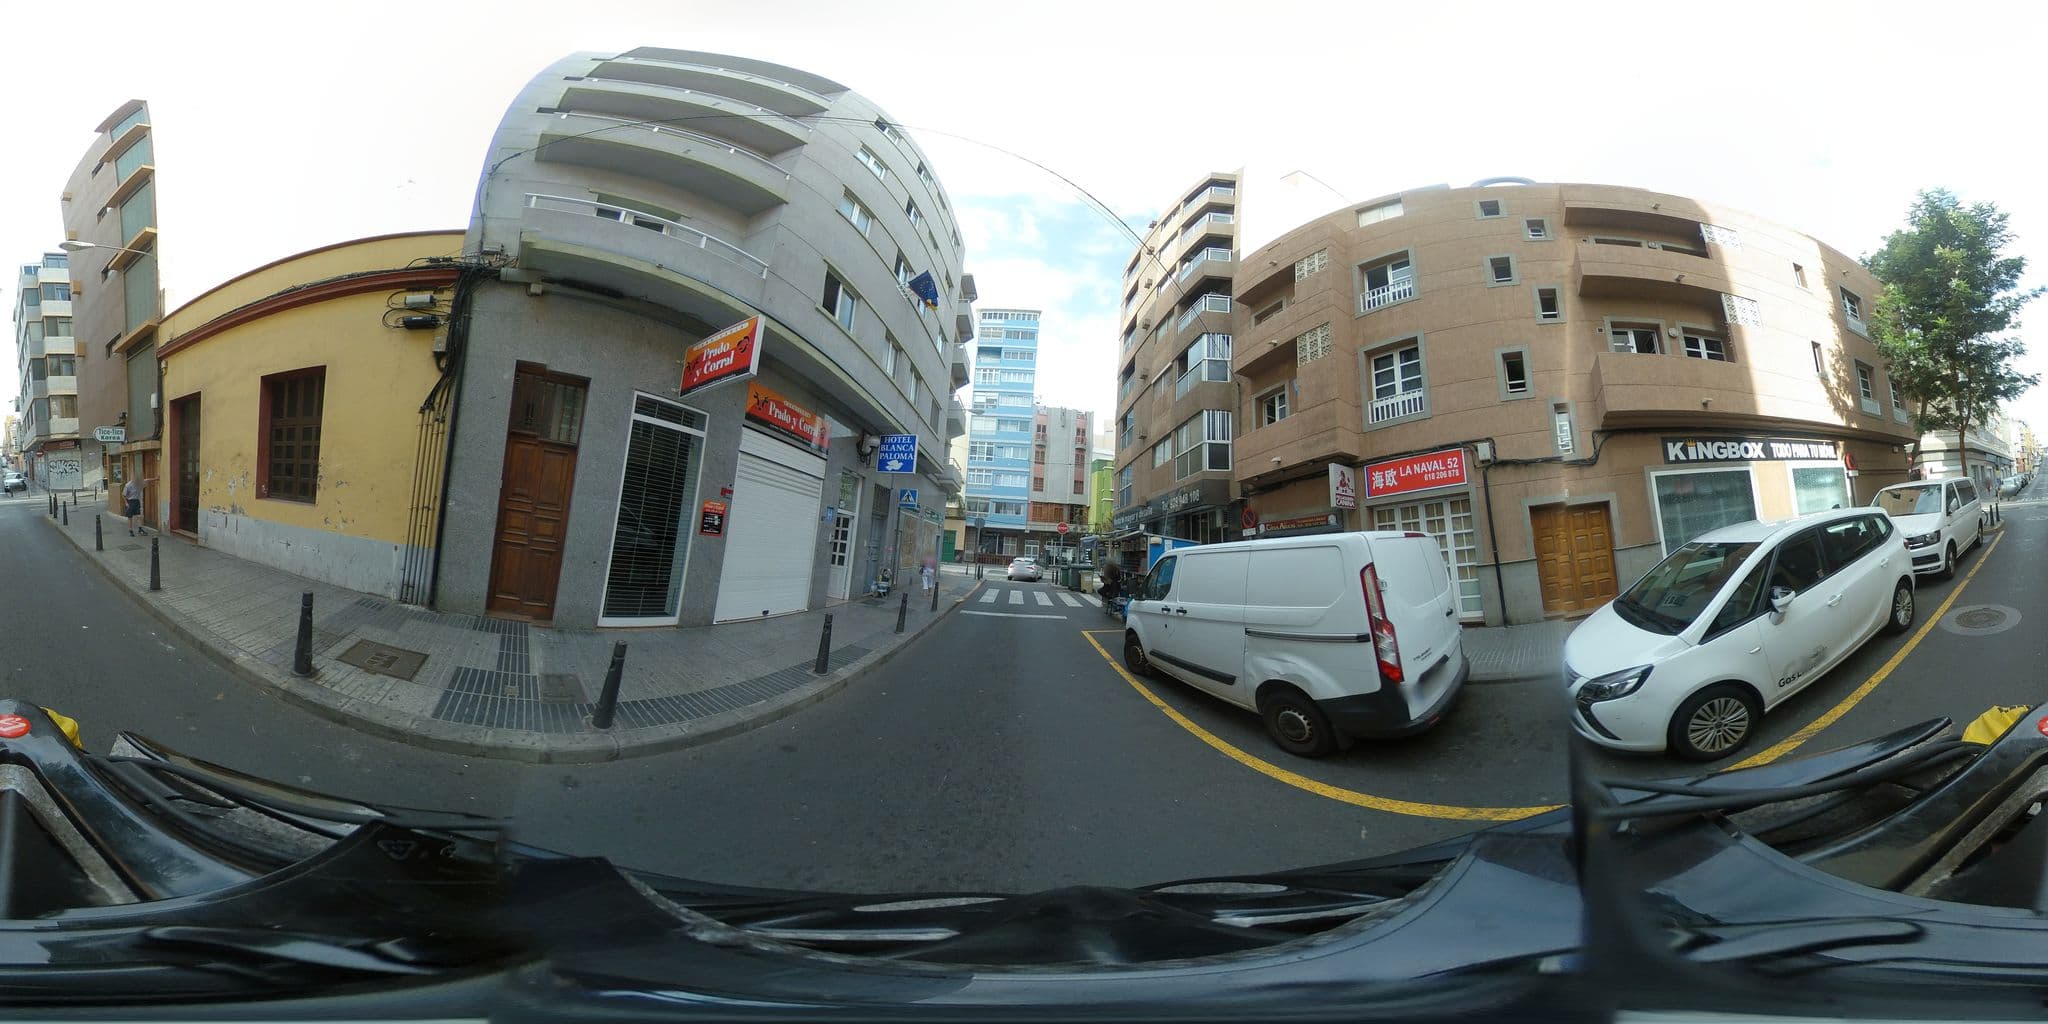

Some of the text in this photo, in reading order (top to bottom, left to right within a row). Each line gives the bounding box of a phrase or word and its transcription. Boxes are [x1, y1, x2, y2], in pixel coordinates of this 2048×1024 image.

[702, 342, 730, 362] Prado
[693, 350, 735, 382] y Corral
[768, 401, 791, 423] Prado
[791, 417, 799, 430] y
[880, 444, 914, 453] BLANCA
[884, 436, 913, 444] HOTEL
[880, 452, 914, 461] PALOMA
[1399, 457, 1459, 477] LA NAVAL 52
